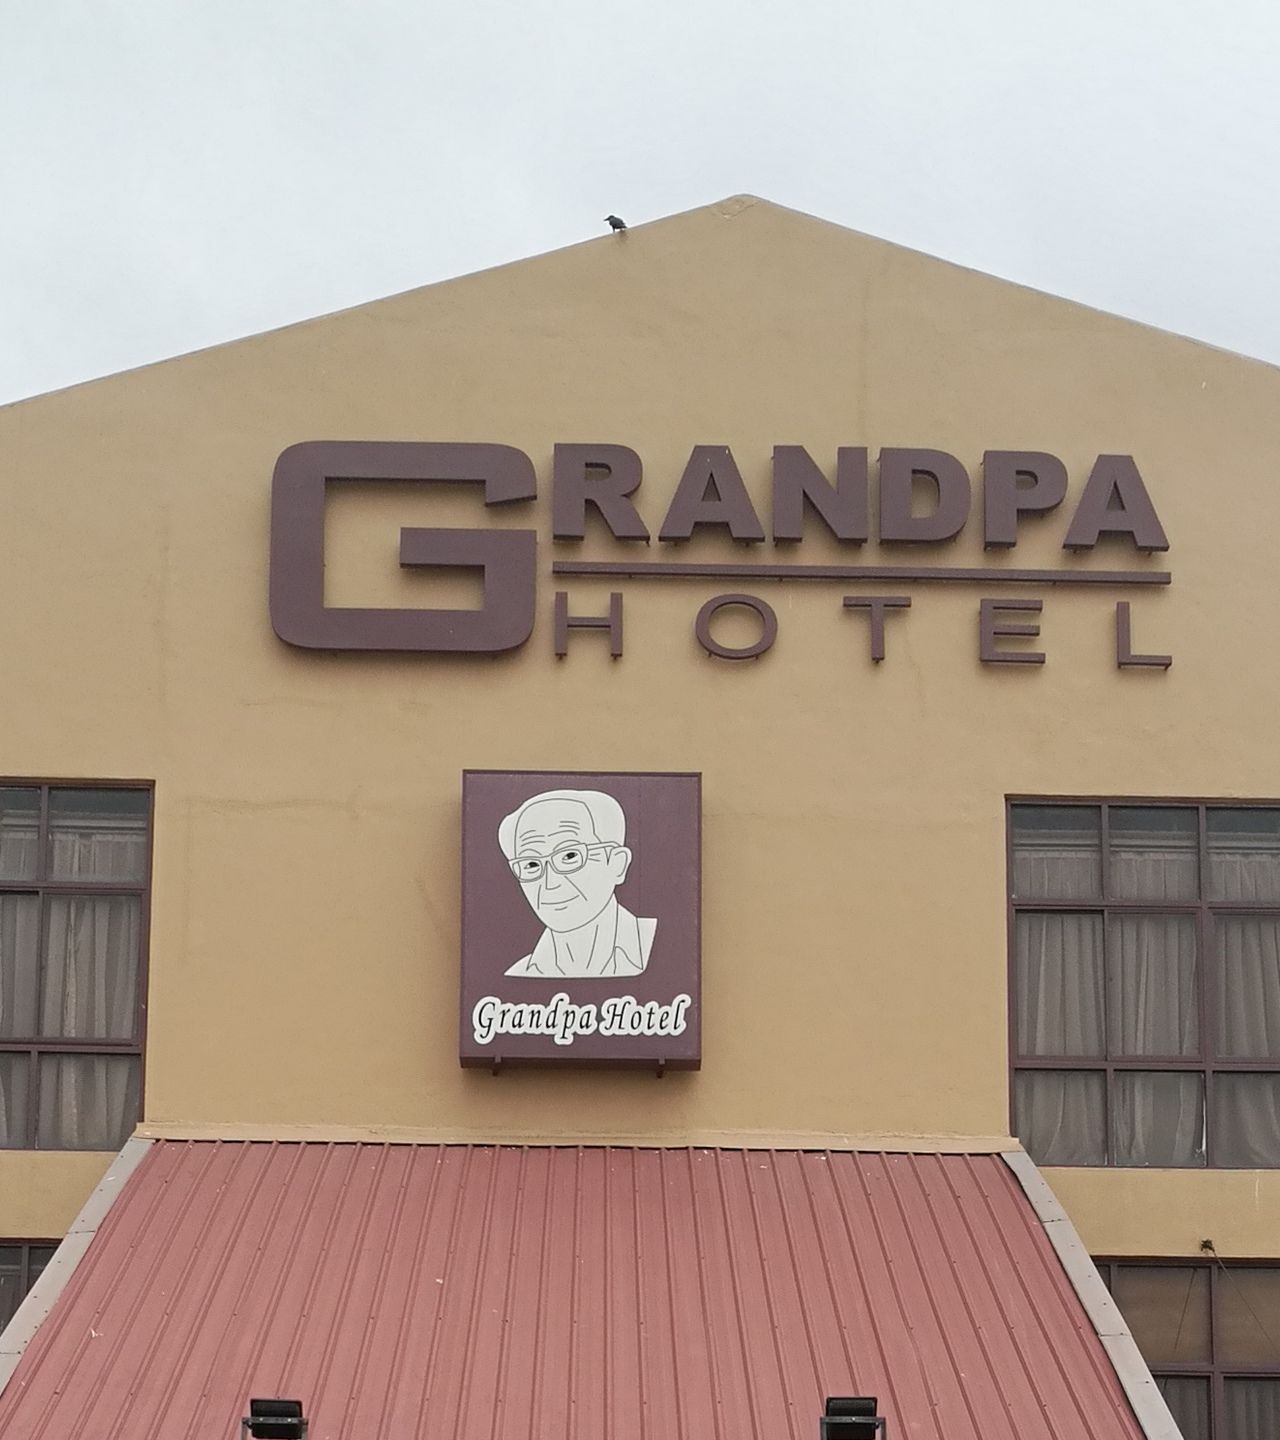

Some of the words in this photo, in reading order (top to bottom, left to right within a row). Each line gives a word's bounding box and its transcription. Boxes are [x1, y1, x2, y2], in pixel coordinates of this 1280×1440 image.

[270, 441, 1171, 652] GRANDPA
[553, 591, 1173, 668] HOTEL
[475, 995, 594, 1041] Grandpa
[602, 997, 688, 1033] Hotel
